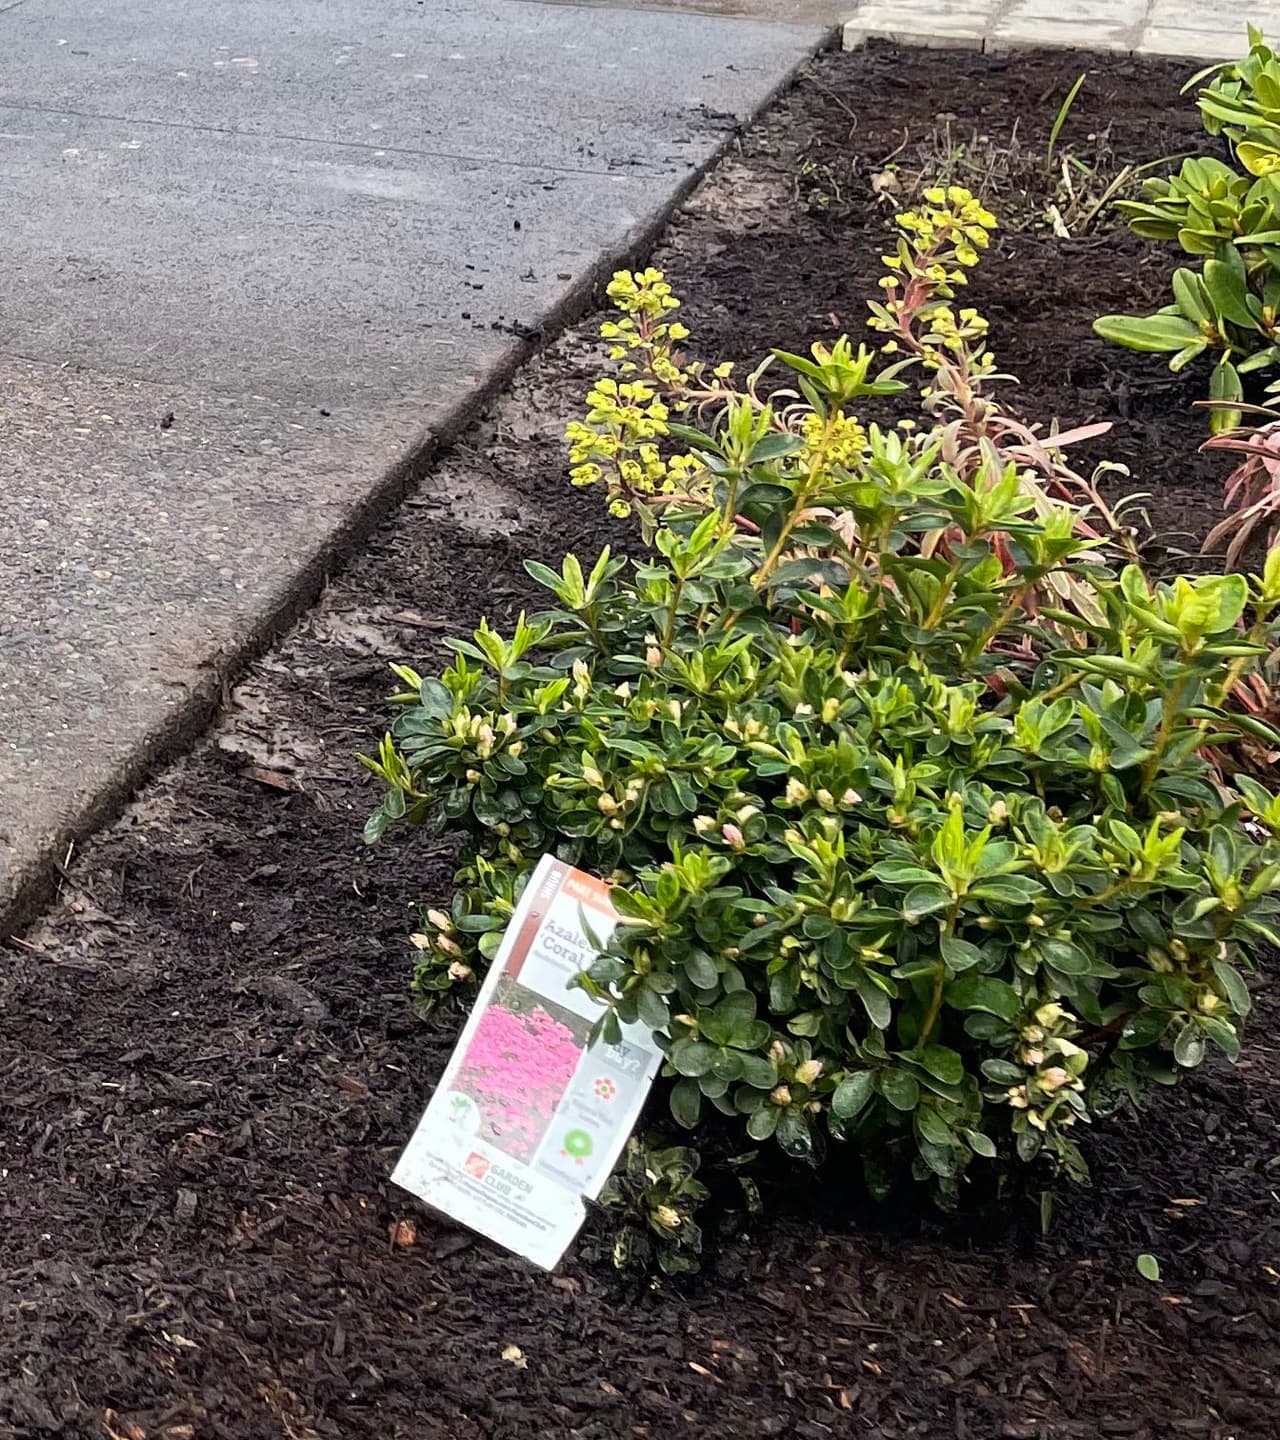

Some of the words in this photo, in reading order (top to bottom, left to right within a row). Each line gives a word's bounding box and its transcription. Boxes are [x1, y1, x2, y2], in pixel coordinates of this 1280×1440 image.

[544, 919, 594, 954] Azale
[484, 1175, 512, 1195] CLUB
[491, 1164, 533, 1194] GARDEN
